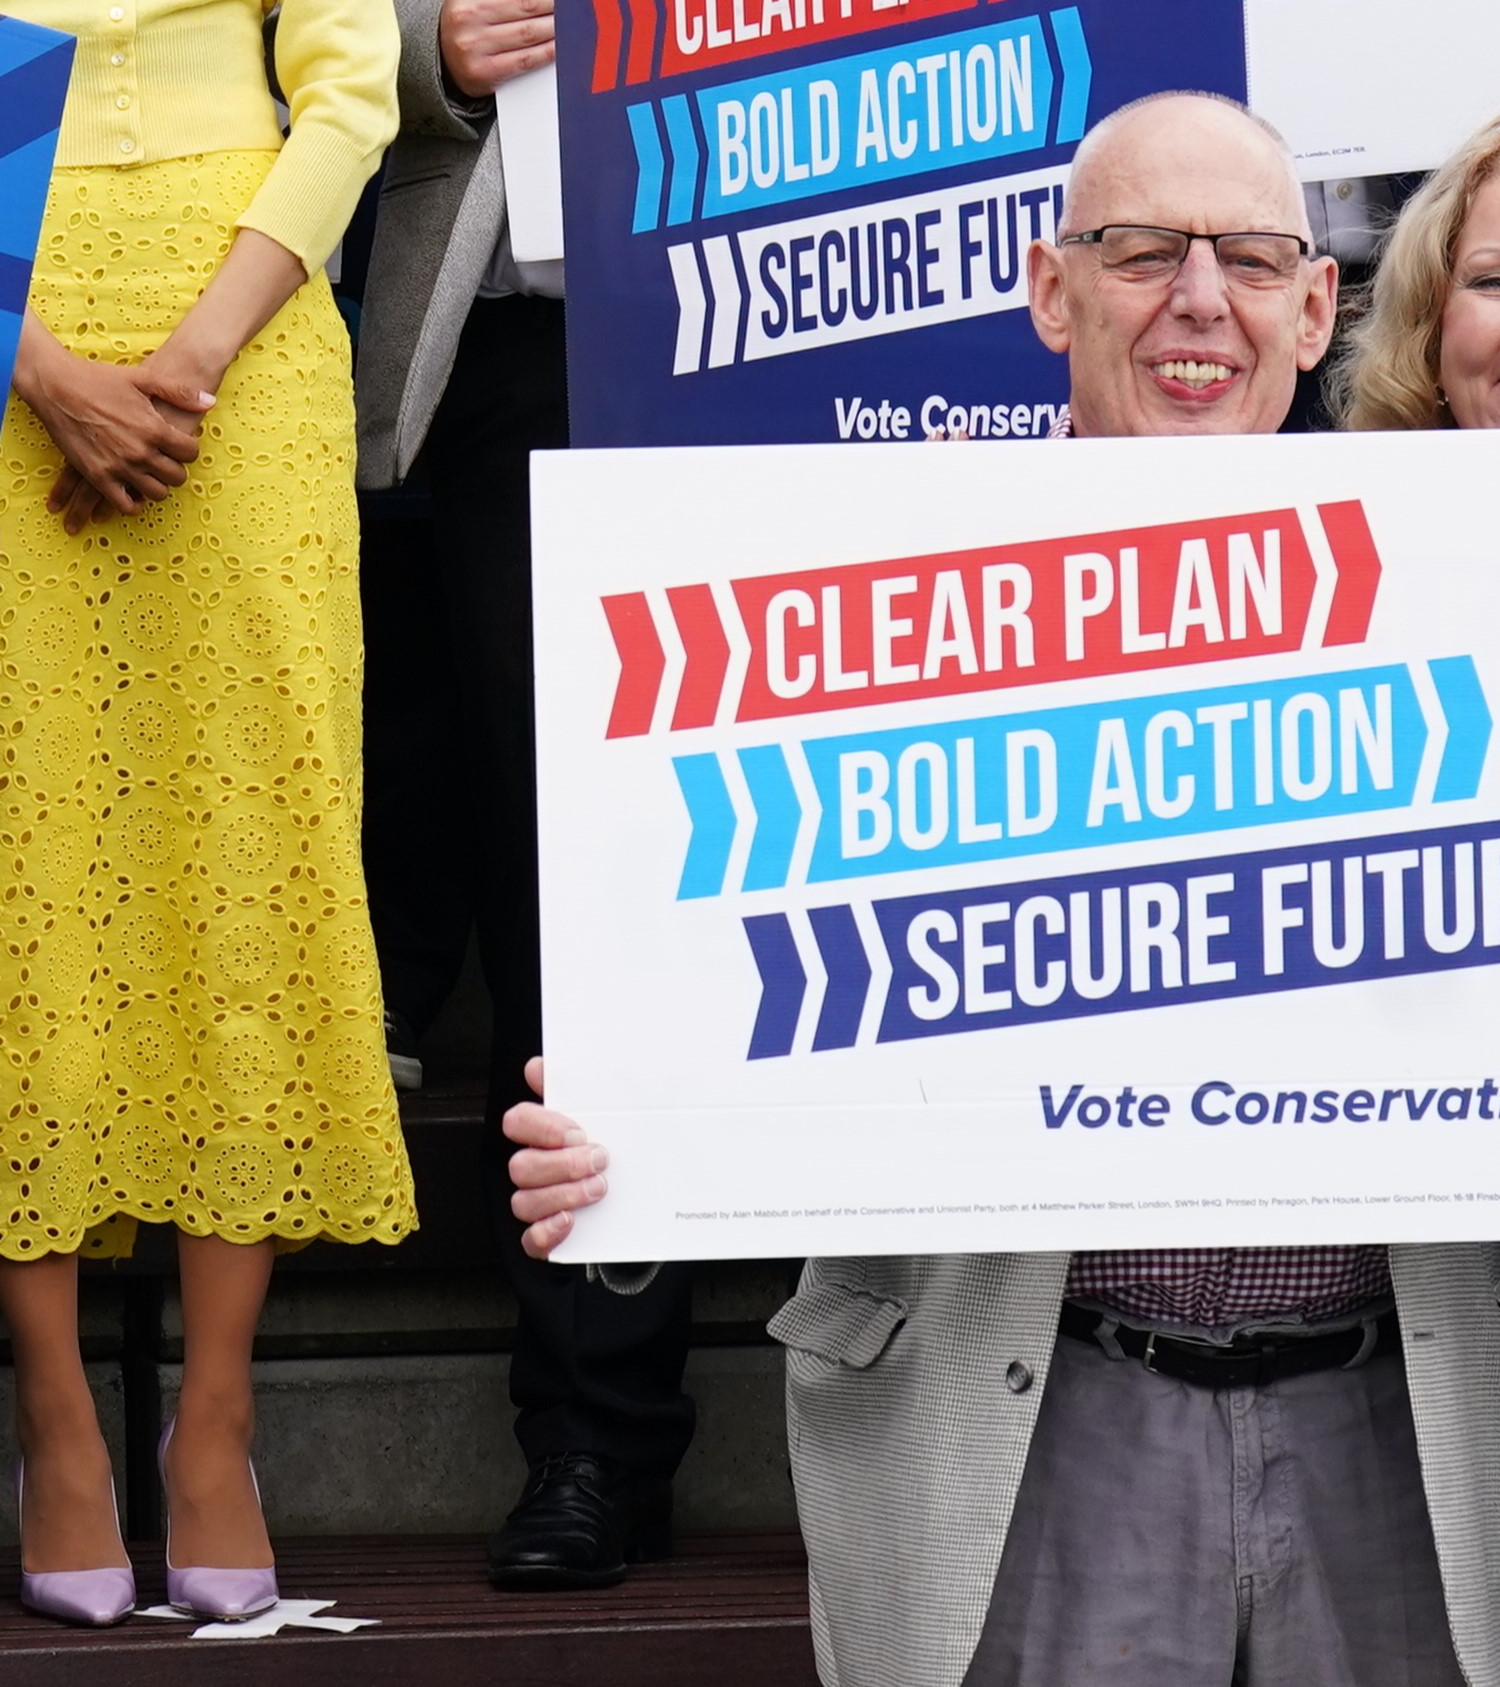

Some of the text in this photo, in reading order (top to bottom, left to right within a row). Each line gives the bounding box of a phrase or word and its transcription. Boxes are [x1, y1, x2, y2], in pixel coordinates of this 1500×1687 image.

[718, 35, 1033, 197] BOLD ACTION
[758, 209, 945, 338] SECURE
[834, 397, 911, 439] Vote
[764, 529, 1283, 700] CLEAR PLAN
[838, 683, 1394, 859] BOLD ACTION
[906, 872, 1237, 1022] SECURE
[1038, 1082, 1172, 1129] Vote
